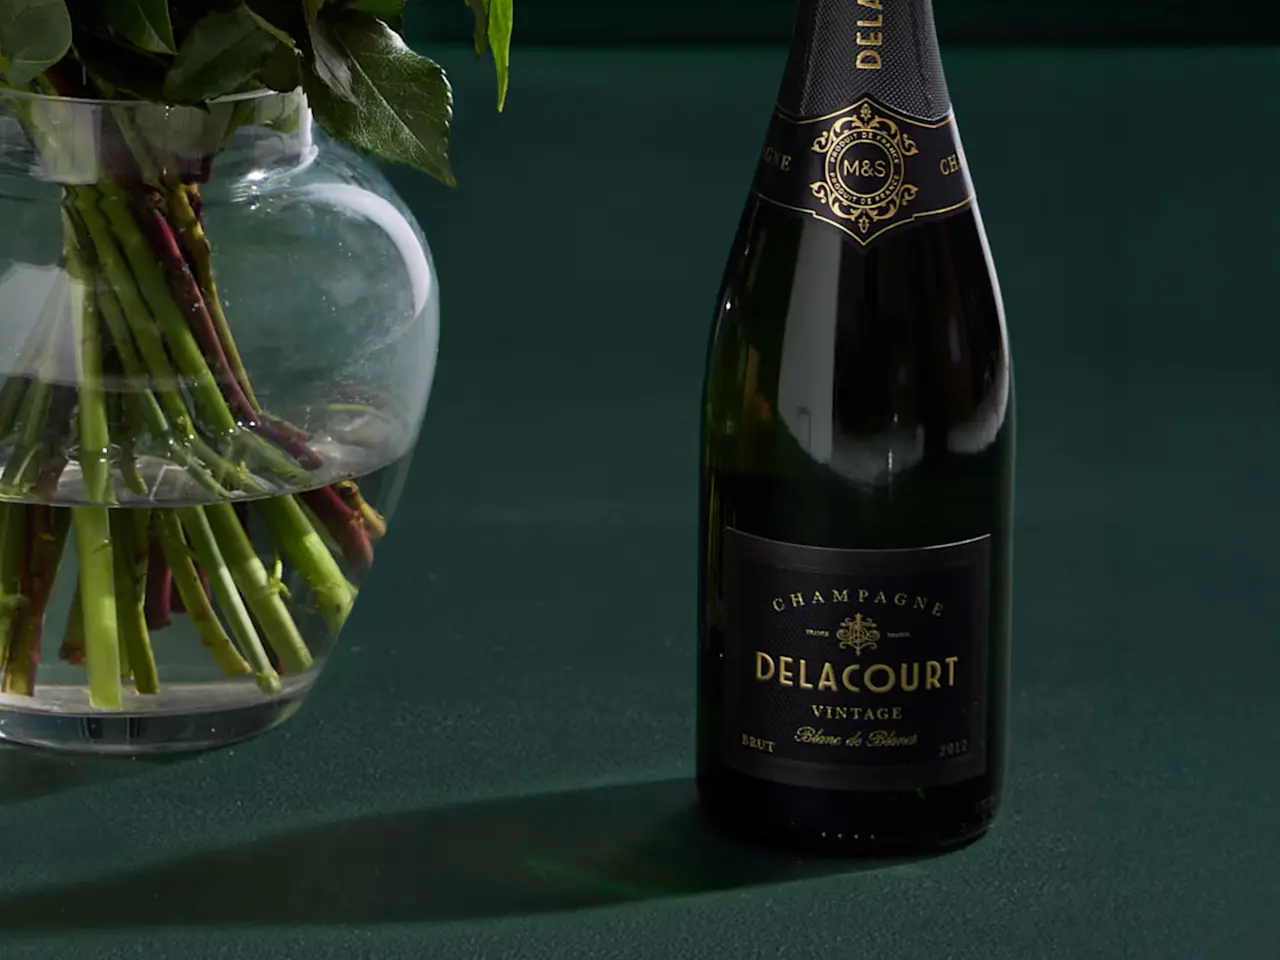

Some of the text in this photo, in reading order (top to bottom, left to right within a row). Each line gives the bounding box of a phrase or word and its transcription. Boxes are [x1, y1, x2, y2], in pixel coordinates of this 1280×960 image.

[829, 131, 900, 165] PRODUIT DE FRANCE
[843, 159, 887, 178] M&S
[829, 171, 900, 205] PRODUIT DE FRANCE
[772, 588, 945, 618] CHAMPAGNE
[754, 650, 959, 694] DELACOURT
[811, 703, 904, 721] VINTAGE
[740, 733, 776, 754] BRUT
